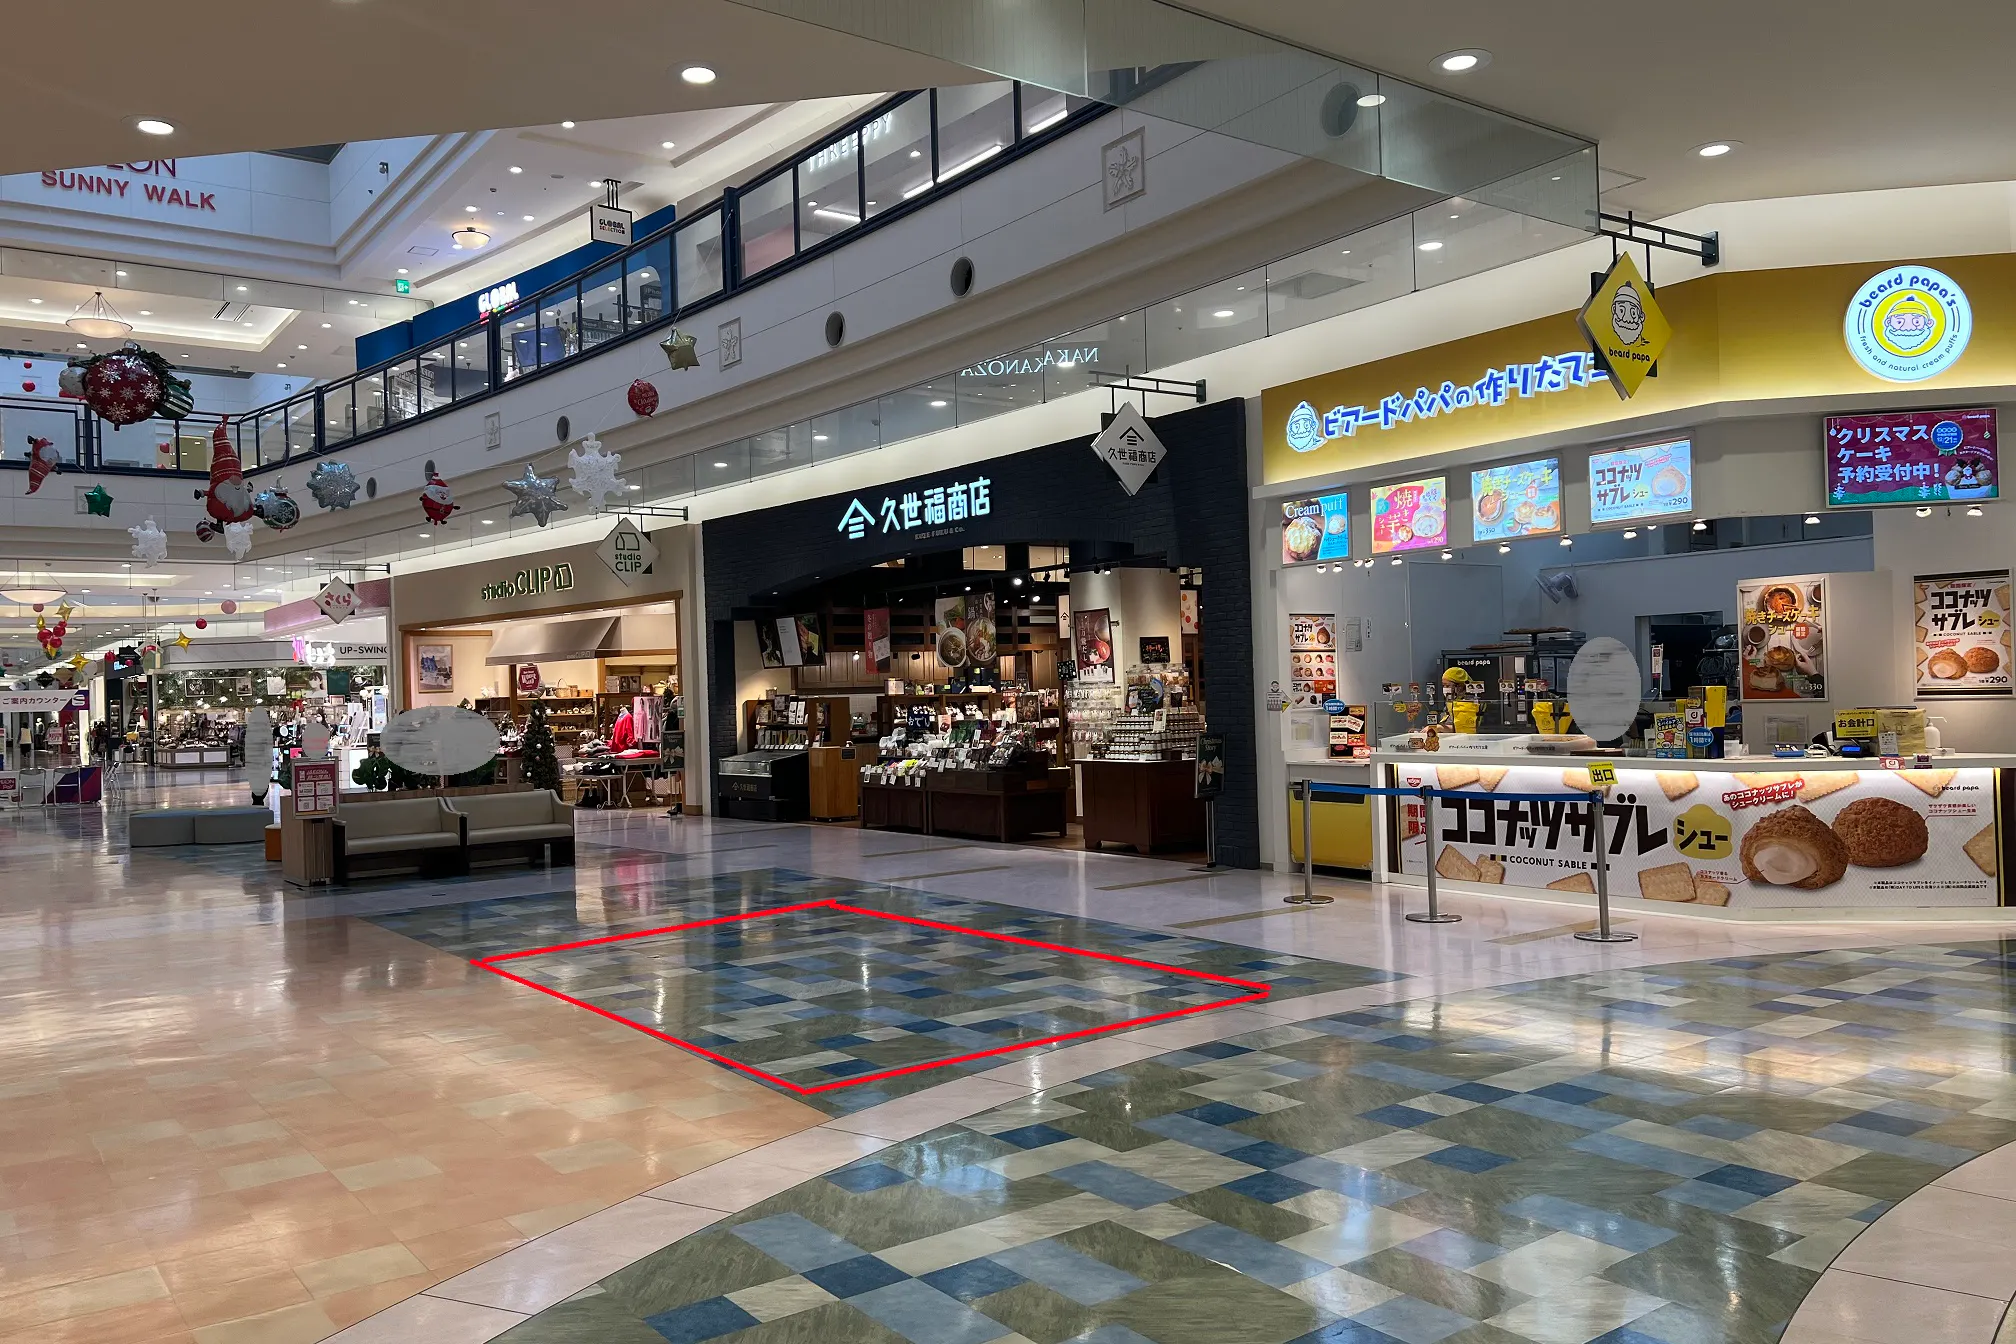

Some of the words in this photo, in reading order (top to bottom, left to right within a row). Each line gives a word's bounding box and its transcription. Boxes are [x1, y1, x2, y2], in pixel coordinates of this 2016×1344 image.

[41, 170, 130, 197] SUNNY
[143, 183, 216, 211] WALK
[1859, 273, 1904, 308] beard
[1909, 275, 1956, 307] papa's
[1608, 346, 1630, 359] beard
[1631, 352, 1651, 363] papa
[1872, 352, 1888, 366] and
[1888, 363, 1919, 372] natural
[1922, 353, 1945, 369] cream
[1837, 425, 1930, 445] クリスマス
[1108, 447, 1156, 463] 久世福商店
[1837, 446, 1893, 464] ケーキ
[1595, 463, 1643, 486] ココナッツ
[880, 476, 991, 534] 久世福商店
[1596, 484, 1632, 506] サブレ
[1285, 503, 1320, 519] Cream
[615, 553, 642, 561] studio
[615, 561, 642, 573] CLIP
[480, 579, 515, 601] studio
[515, 566, 552, 596] CLIP
[325, 592, 351, 607] さくら
[1931, 589, 1992, 609] ココナッツ
[1745, 605, 1820, 625] 焼きチーズケーキ
[1932, 608, 1976, 631] サブレ
[1978, 615, 2000, 626] シュー
[2, 697, 68, 705] ご案内カウンター
[1838, 718, 1875, 728] お会計口
[1592, 769, 1615, 782] 出口
[1723, 780, 1803, 802] あのココナッツサブレが
[1441, 793, 1668, 856] ココナッツサブレ
[1676, 818, 1729, 851] シュー
[1509, 855, 1554, 868] COCONUT
[1557, 857, 1588, 870] SABLE
